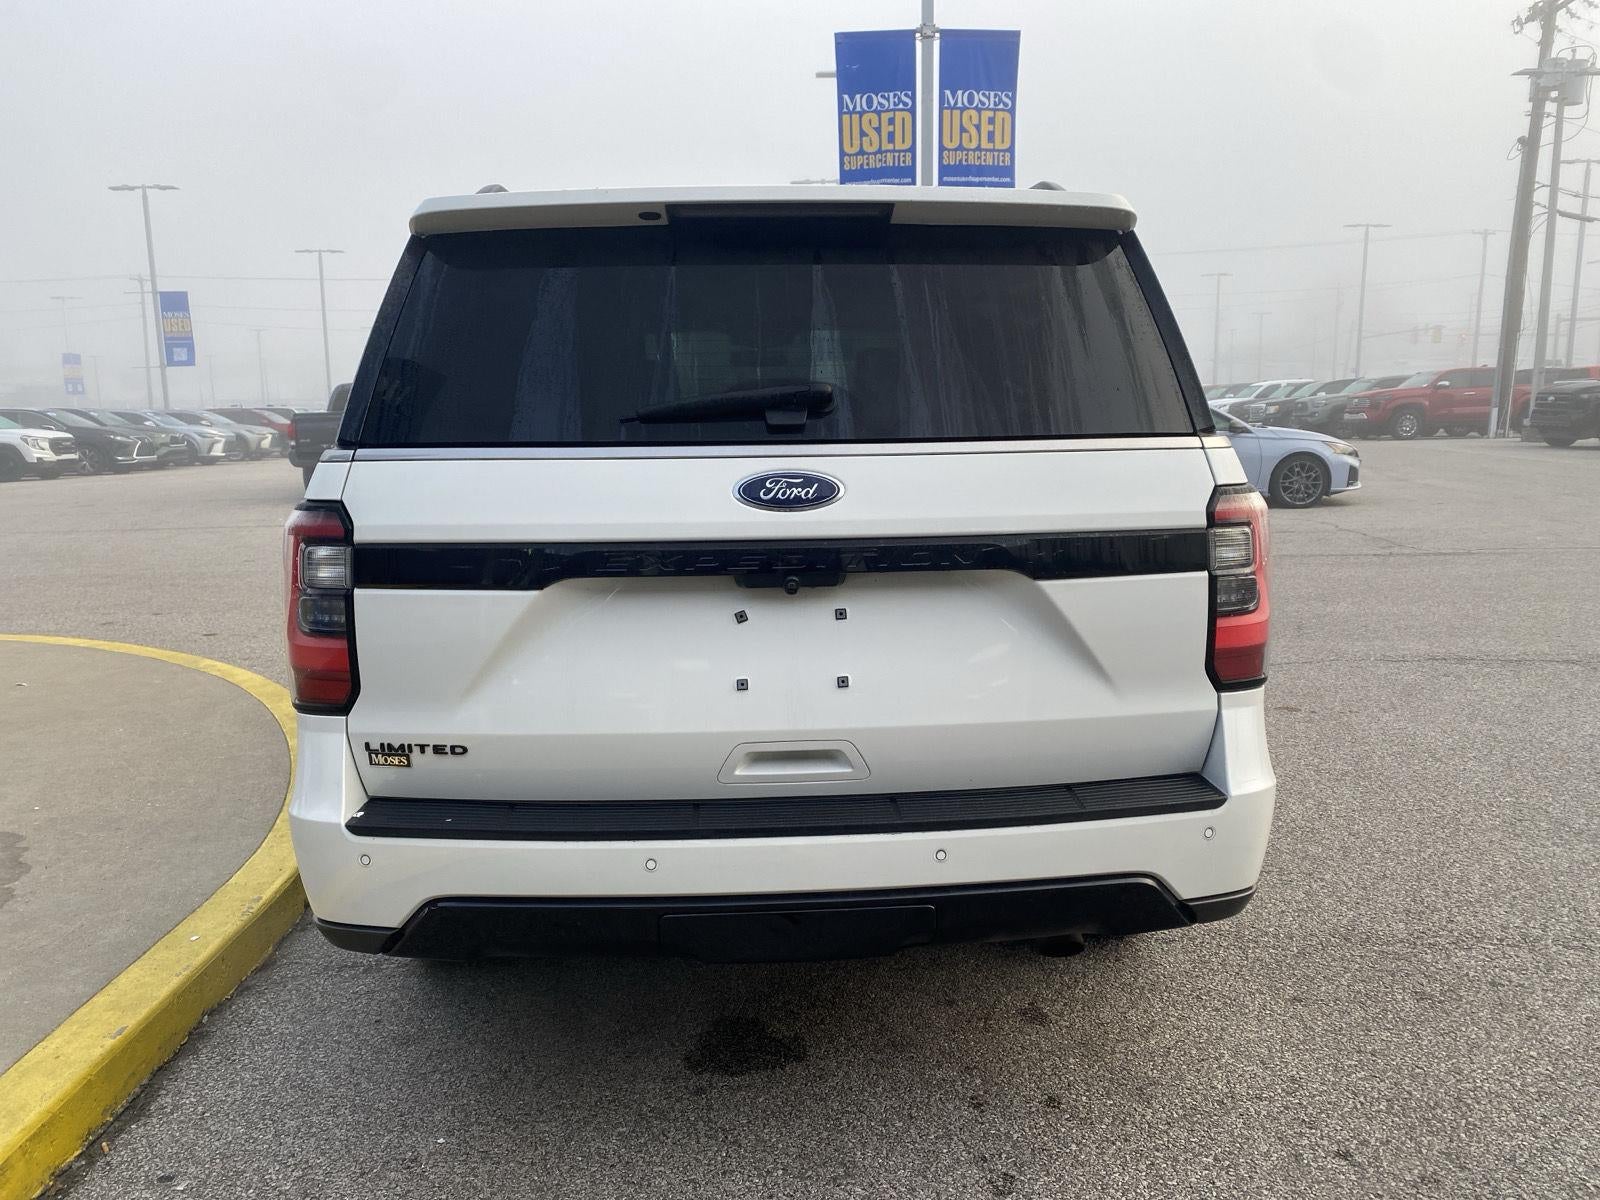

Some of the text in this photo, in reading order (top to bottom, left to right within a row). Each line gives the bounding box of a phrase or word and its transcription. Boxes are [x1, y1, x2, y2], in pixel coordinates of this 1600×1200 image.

[842, 91, 912, 112] MOSES
[943, 89, 1012, 109] MOSES
[842, 111, 912, 154] USED
[942, 109, 1011, 149] USED
[843, 152, 912, 170] SUPERCENTER
[943, 151, 1011, 166] SUPERCENTER
[164, 319, 191, 332] USED
[760, 478, 818, 500] Ford
[597, 548, 992, 572] EXPEDITION
[364, 742, 468, 756] LIMITED
